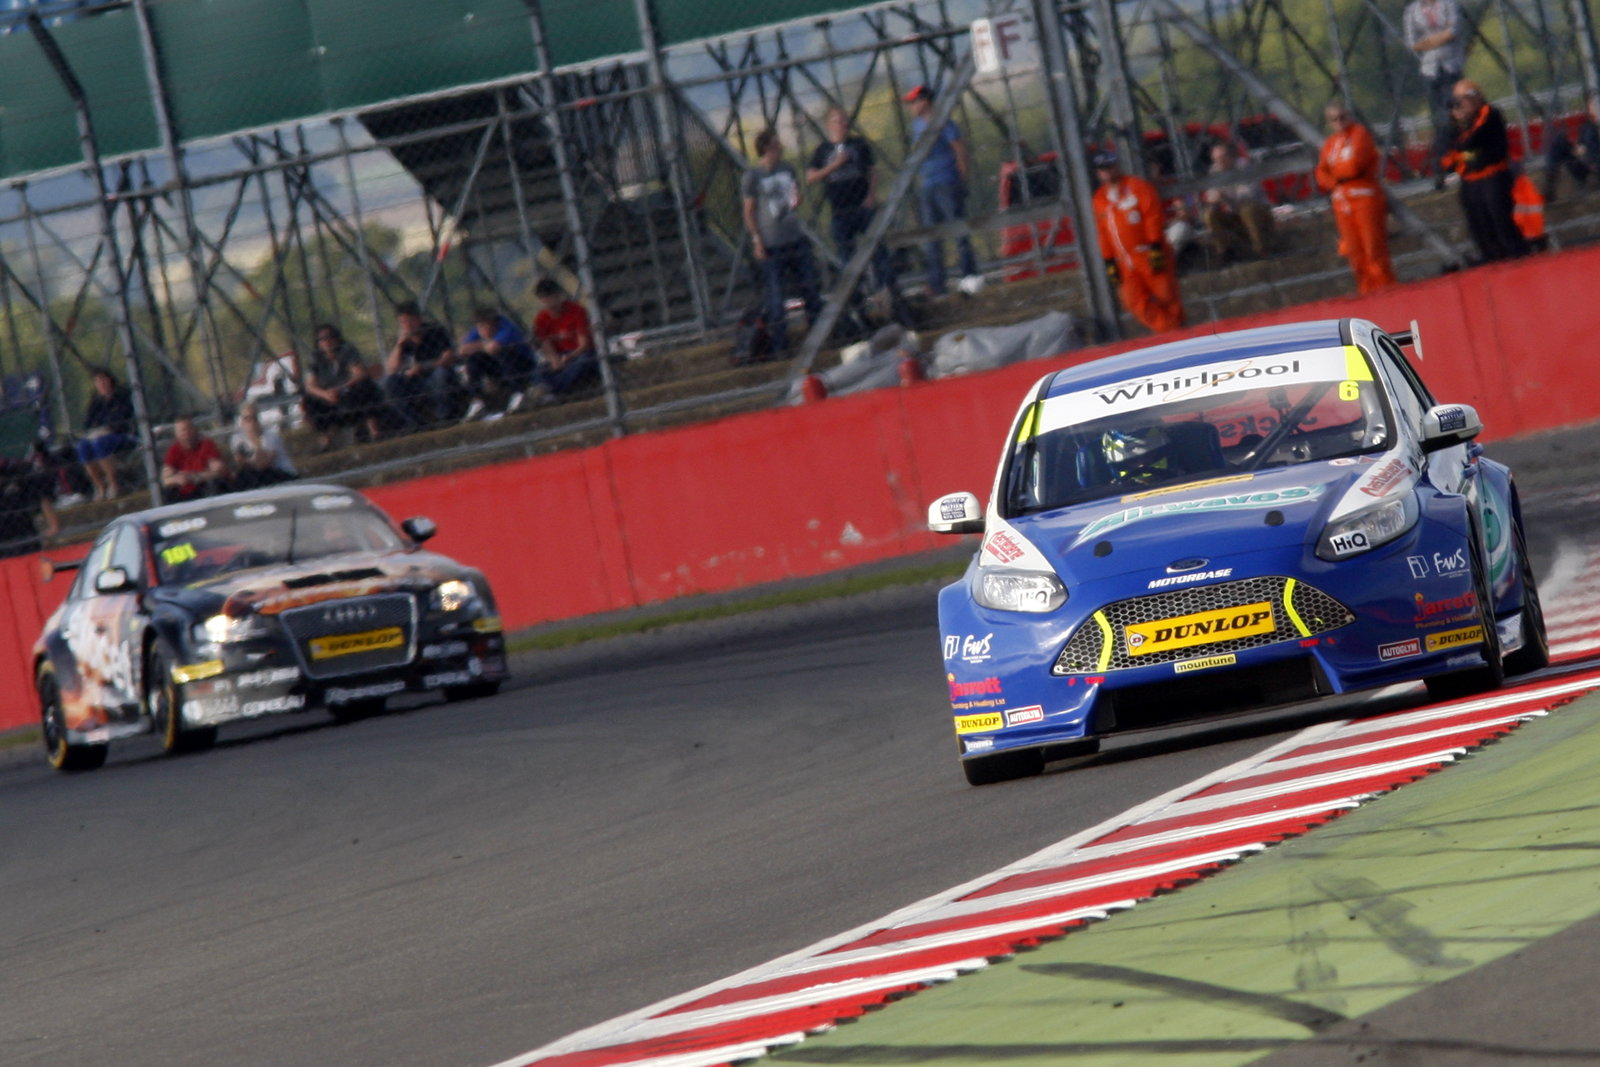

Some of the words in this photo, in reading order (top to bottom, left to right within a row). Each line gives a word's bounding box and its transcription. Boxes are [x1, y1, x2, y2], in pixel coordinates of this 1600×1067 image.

[1099, 361, 1299, 404] Whirlpool
[1338, 381, 1360, 401] 6
[1333, 533, 1367, 551] HiQ
[1148, 568, 1233, 589] MOTORBASE
[1152, 610, 1270, 643] DUNLOP
[1439, 629, 1482, 646] DUNLOP
[1176, 655, 1235, 673] mountune
[960, 717, 1000, 729] DUNLOP
